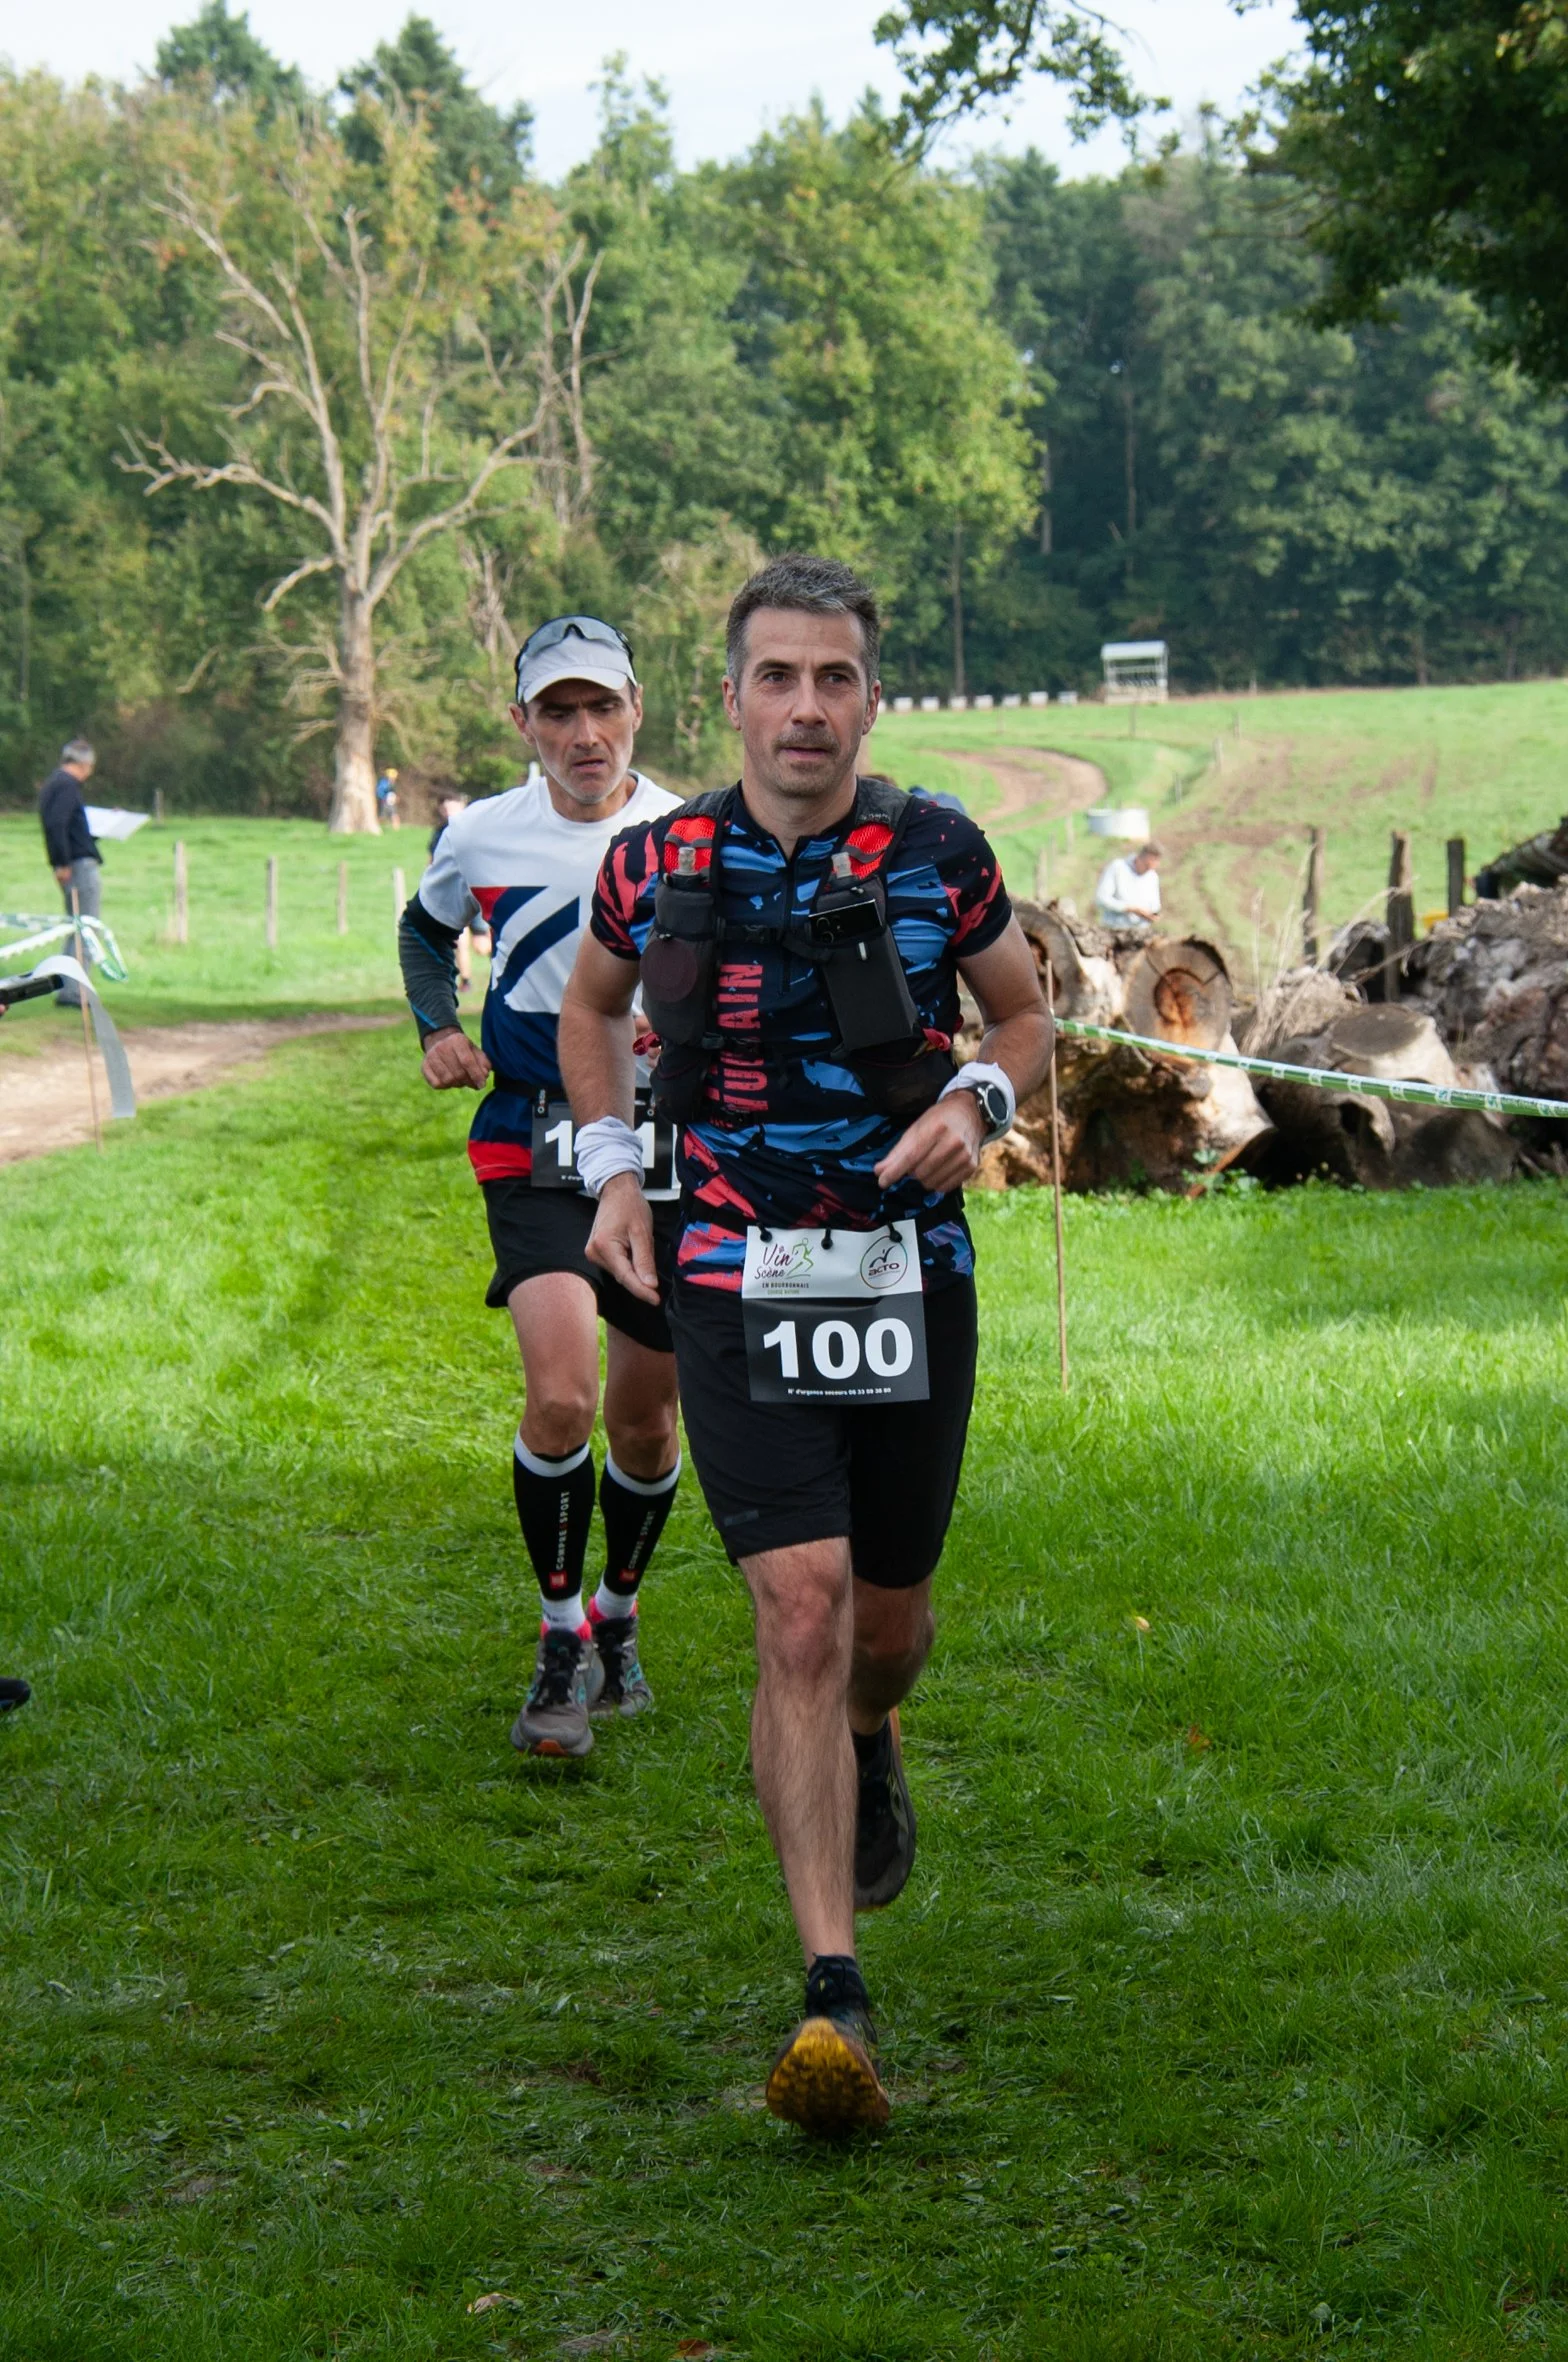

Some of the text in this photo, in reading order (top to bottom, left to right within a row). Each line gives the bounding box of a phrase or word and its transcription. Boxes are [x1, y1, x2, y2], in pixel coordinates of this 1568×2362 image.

[545, 1120, 655, 1169] 11
[763, 1317, 913, 1380] 100
[556, 1491, 570, 1571] COMPRESSPORT
